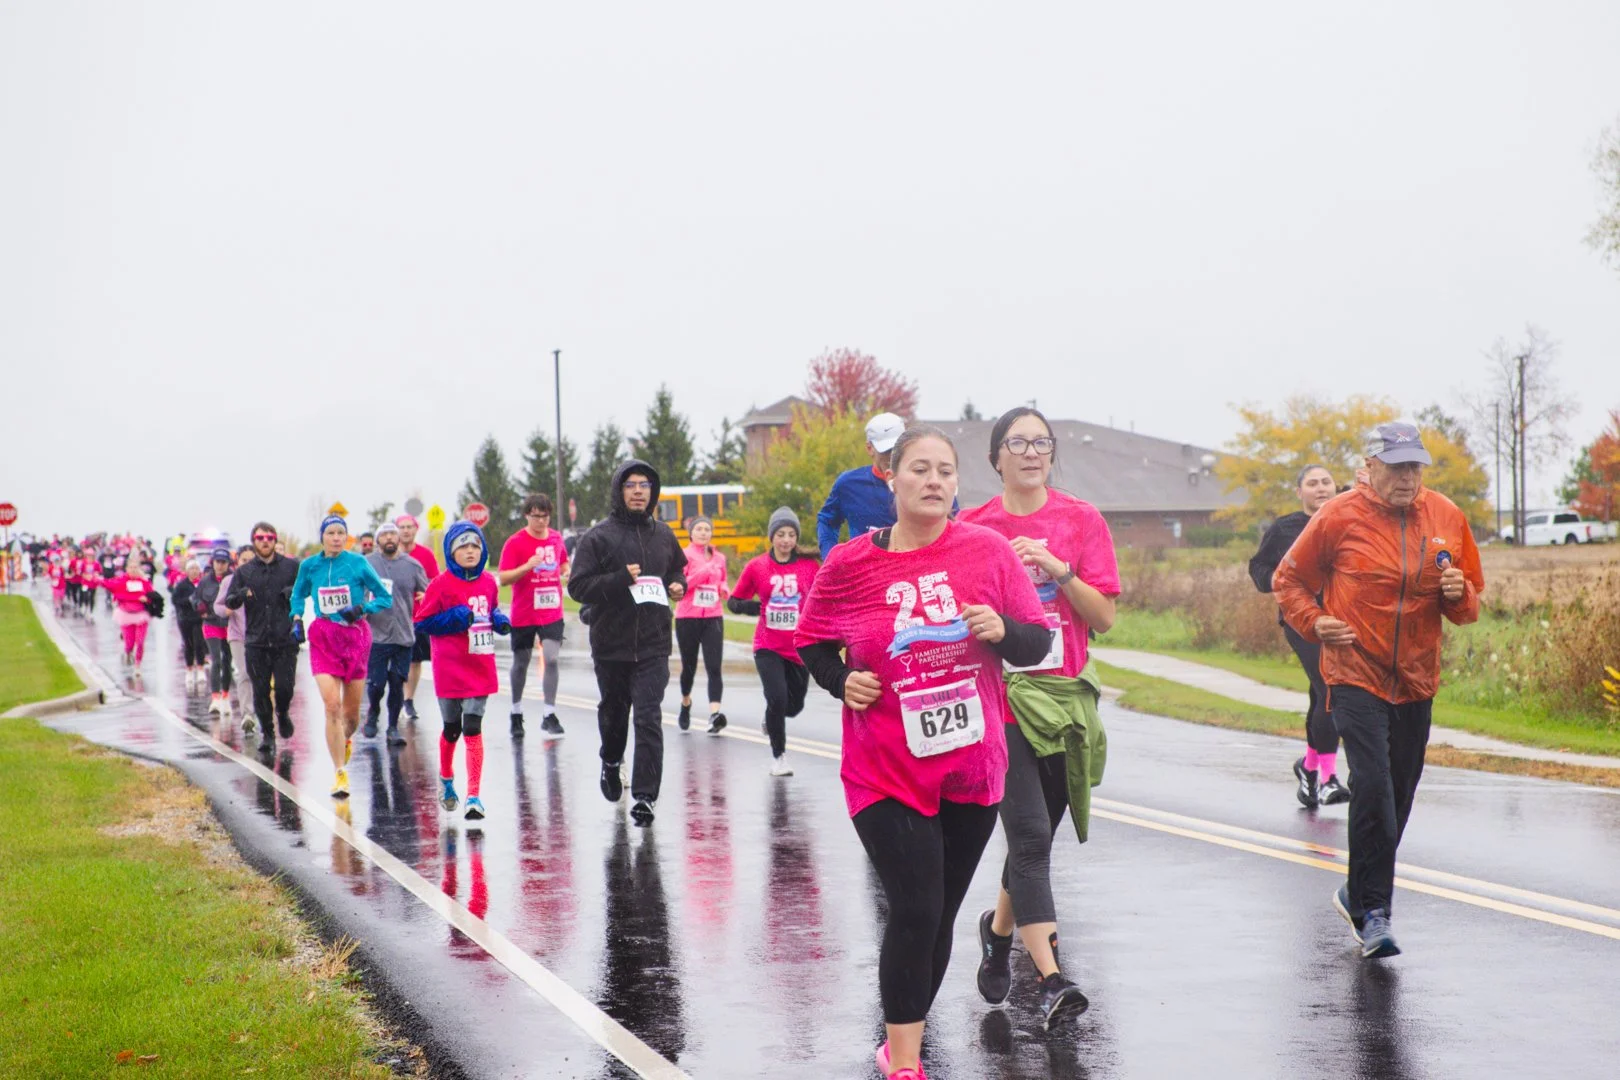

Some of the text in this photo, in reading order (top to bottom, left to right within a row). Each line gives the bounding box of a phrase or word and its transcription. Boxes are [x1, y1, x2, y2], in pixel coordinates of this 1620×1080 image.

[0, 507, 17, 520] TOP
[466, 509, 488, 520] STOP
[770, 574, 797, 597] 25
[322, 594, 349, 607] 1438
[540, 594, 555, 604] 692
[885, 571, 957, 633] 25
[770, 612, 796, 623] 1685
[915, 641, 968, 660] FAMILY HEALTH
[919, 649, 967, 664] PARTNERSHIP
[931, 657, 956, 667] CLINIC
[920, 702, 969, 738] 629
